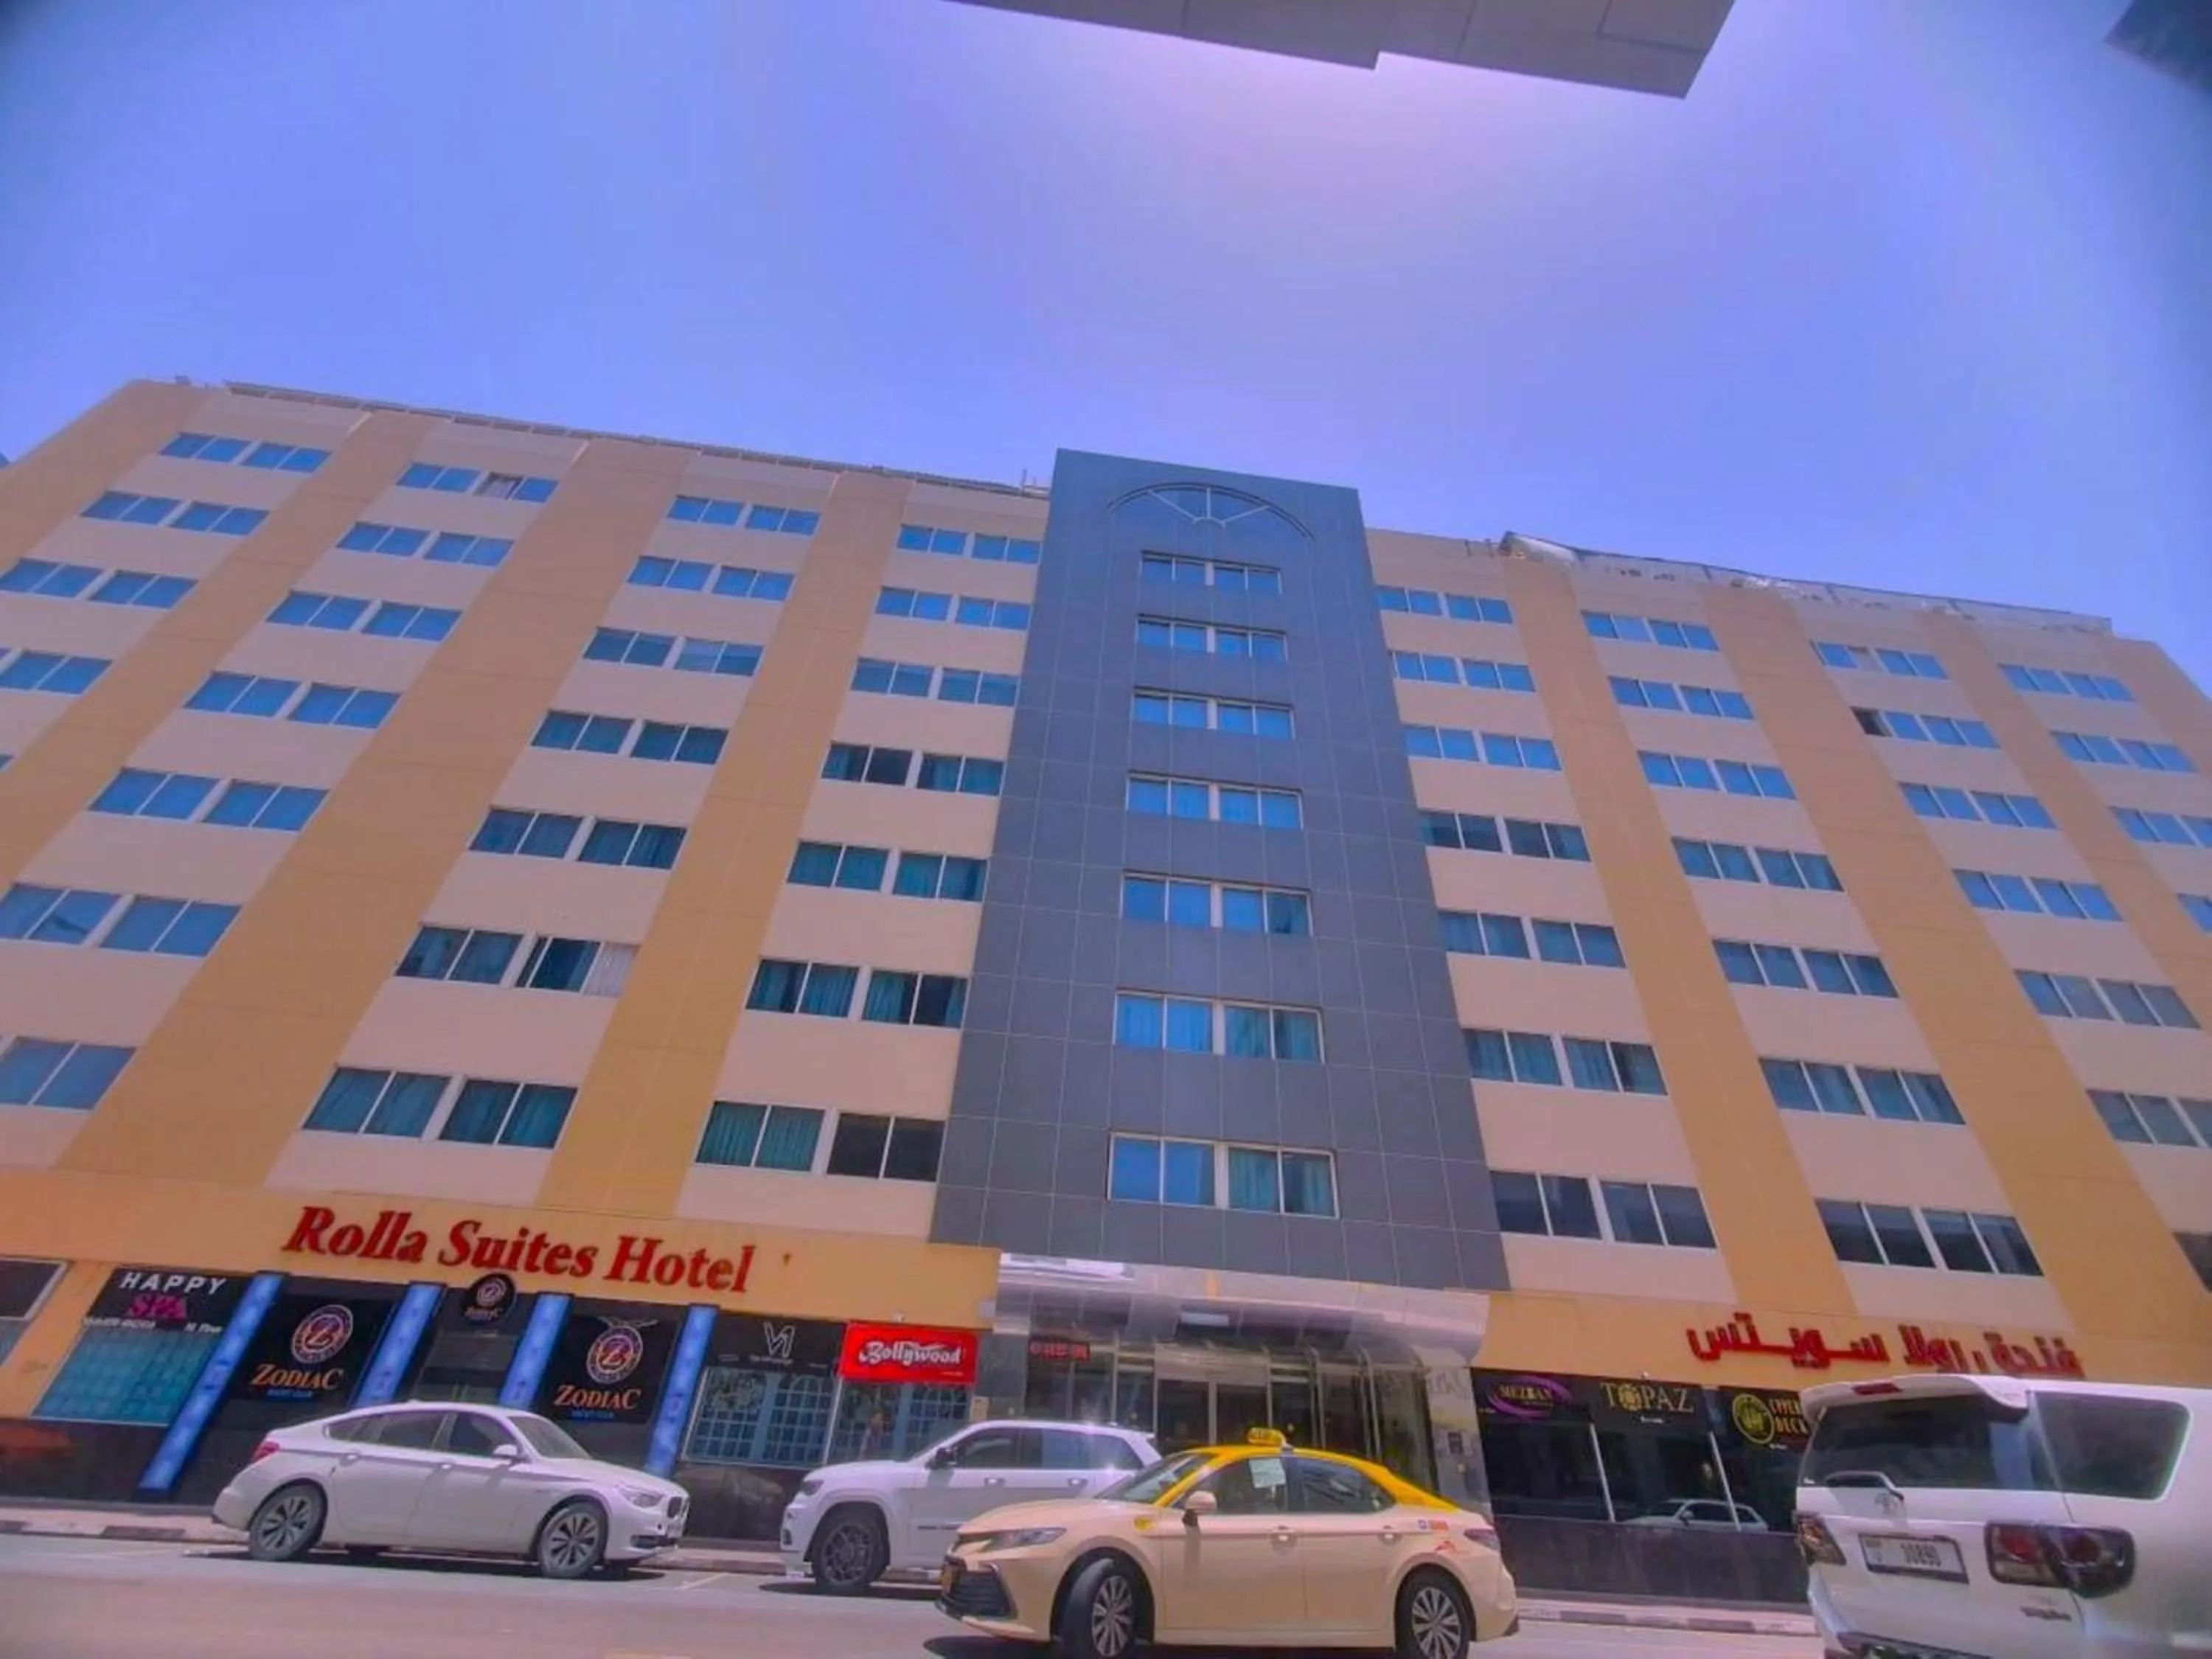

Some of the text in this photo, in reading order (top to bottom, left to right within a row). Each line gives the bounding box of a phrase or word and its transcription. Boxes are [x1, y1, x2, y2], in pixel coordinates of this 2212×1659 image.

[282, 1206, 757, 1293] Rolla Suites Hotel
[119, 1271, 226, 1295] HAPPY
[858, 1339, 964, 1366] Bollywood
[251, 1363, 344, 1390] ZODIAC
[554, 1384, 641, 1410] ZODIAC
[1599, 1382, 1694, 1413] TOPAZ
